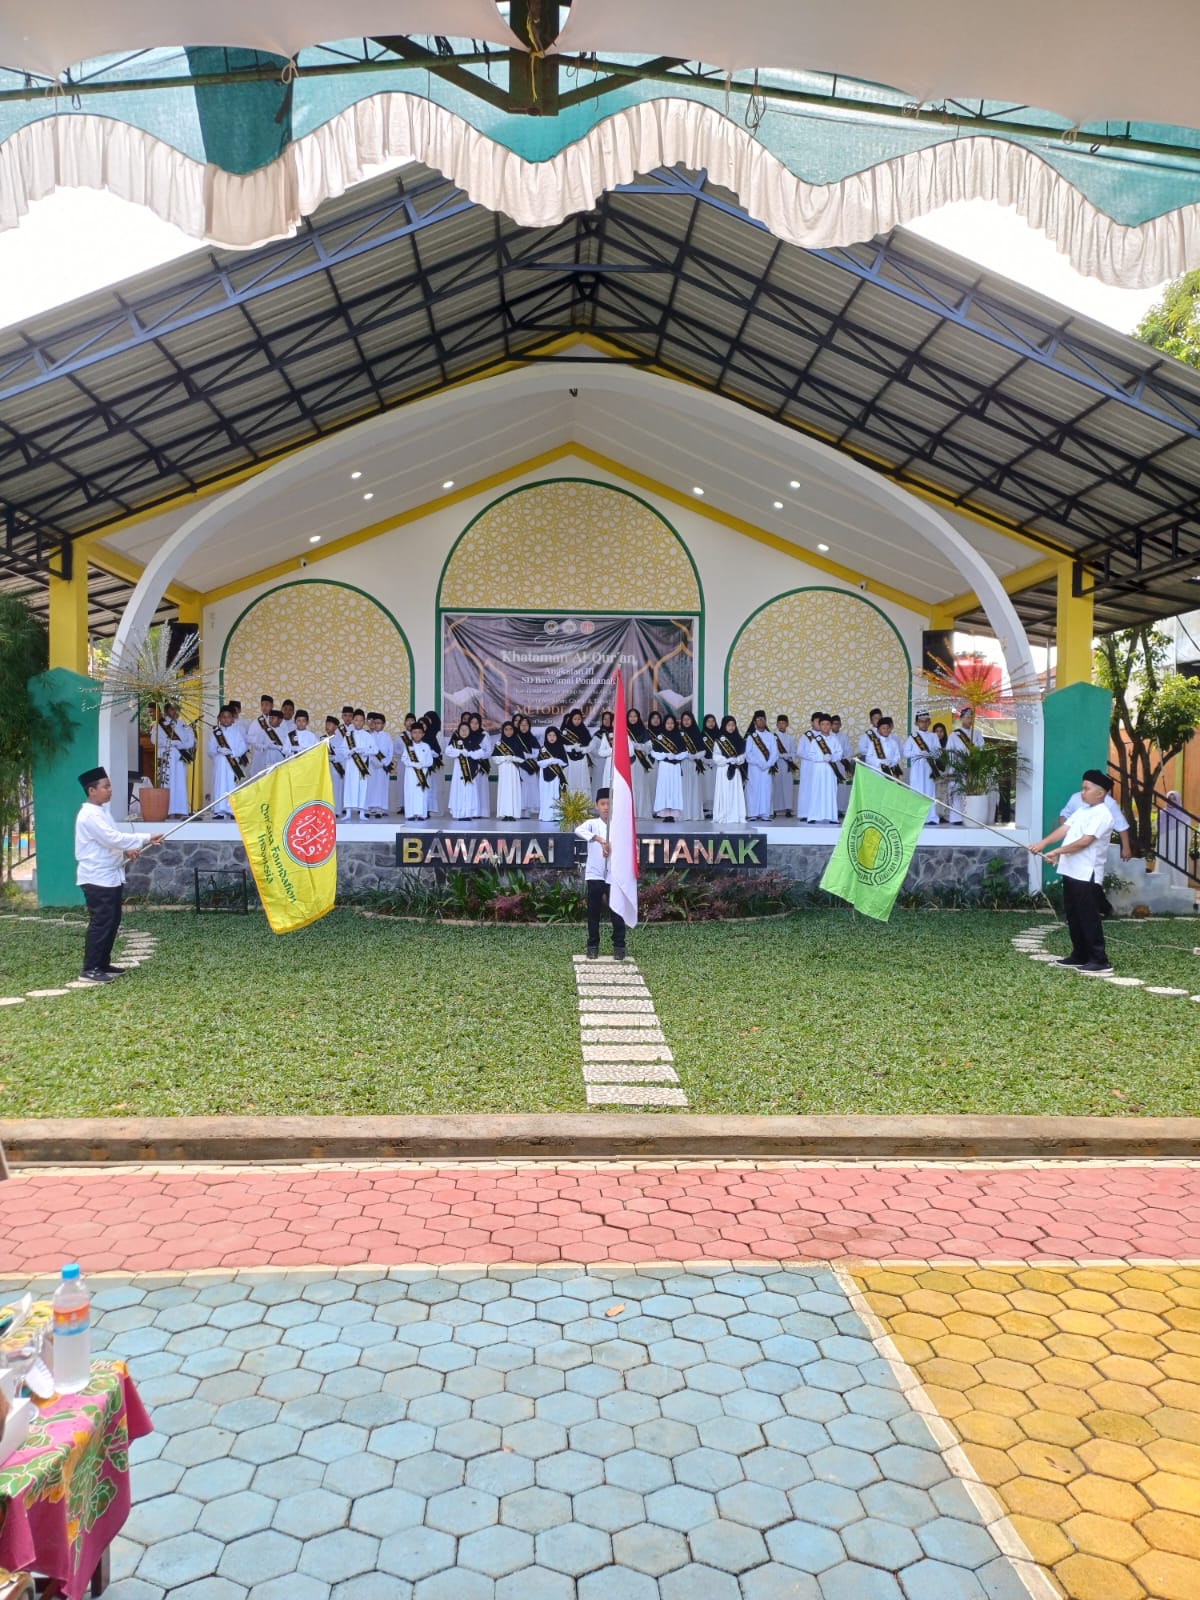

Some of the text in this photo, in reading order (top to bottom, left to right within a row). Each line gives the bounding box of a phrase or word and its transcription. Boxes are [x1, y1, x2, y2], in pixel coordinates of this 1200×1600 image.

[501, 650, 568, 663] Khataman
[521, 676, 533, 684] SD
[575, 676, 616, 685] Pontianak
[257, 833, 273, 884] Indonesia
[402, 838, 554, 865] BAWAMAI
[271, 845, 297, 903] Foundation
